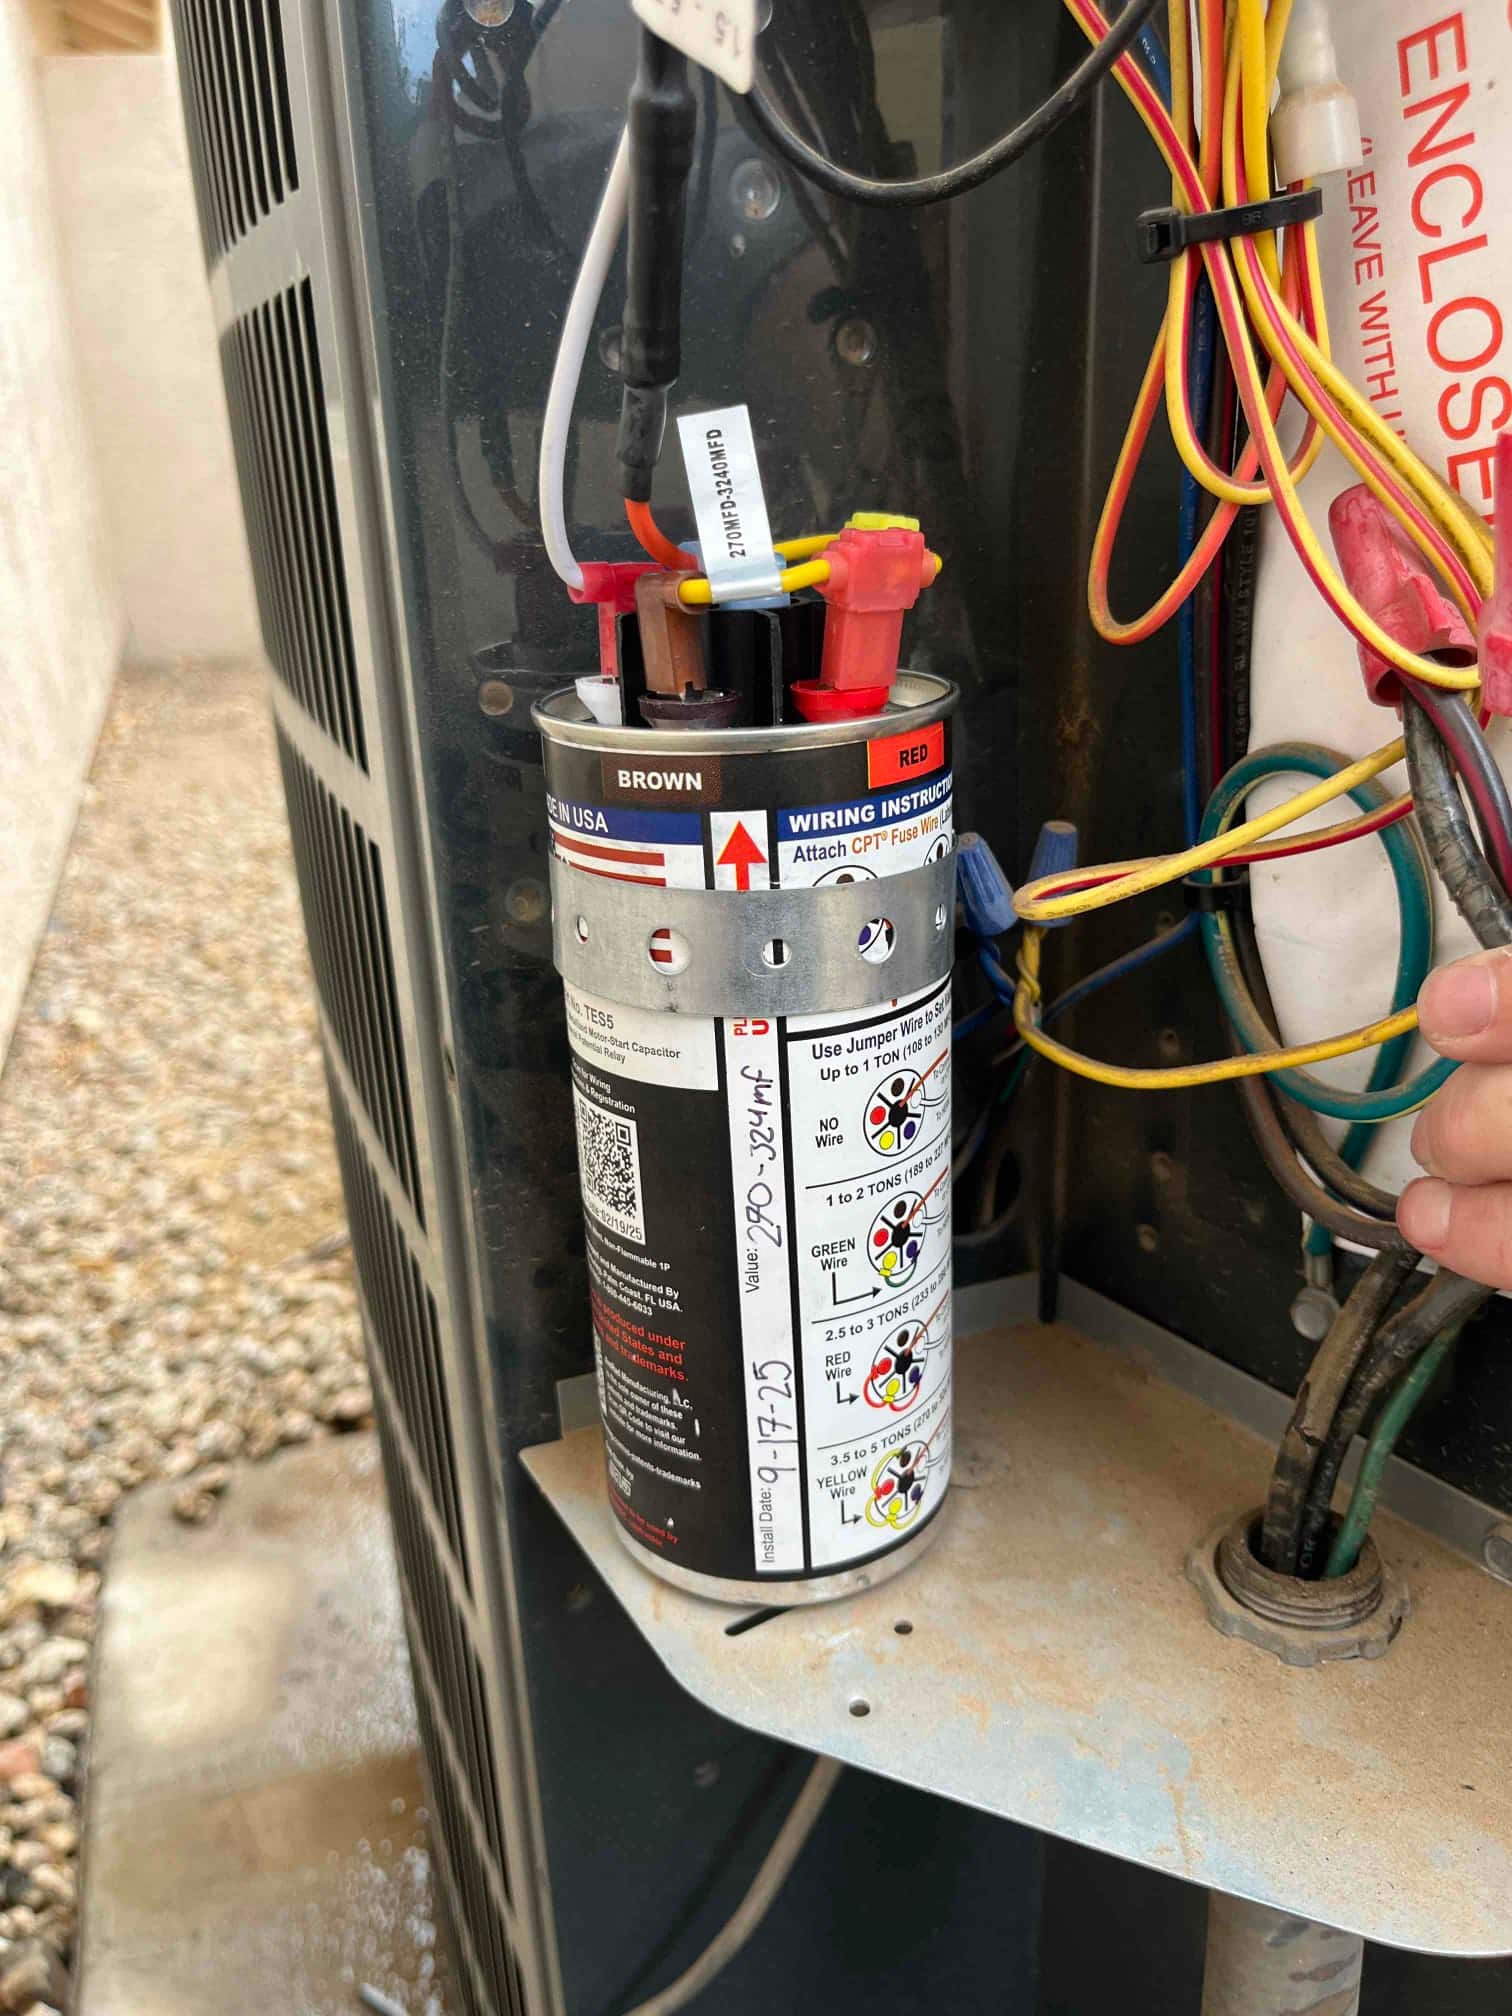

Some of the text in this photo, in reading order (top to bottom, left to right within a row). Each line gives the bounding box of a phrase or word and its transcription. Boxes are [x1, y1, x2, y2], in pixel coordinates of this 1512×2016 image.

[1346, 168, 1385, 286] EAVE
[1397, 12, 1512, 526] ENCLOSE
[1359, 289, 1399, 402] WITH
[705, 428, 747, 559] 270MFD-3240MFD
[898, 743, 930, 769] RED
[617, 769, 703, 791] BROWN
[559, 800, 571, 825] IN
[573, 806, 609, 833] USA
[789, 804, 876, 833] WIRING
[793, 840, 847, 864] Attach
[891, 826, 919, 847] Fuse
[920, 815, 940, 837] Wire
[584, 1003, 615, 1030] TES5
[733, 1016, 749, 1036] PL
[812, 1044, 843, 1060] Use
[846, 1028, 898, 1054] Jumper
[900, 1016, 924, 1038] Wire
[925, 1008, 934, 1024] to
[934, 999, 945, 1019] Set
[604, 1046, 626, 1065] Relay
[631, 1041, 682, 1060] Capacitor
[820, 1067, 841, 1082] Up
[845, 1062, 859, 1077] to
[863, 1059, 870, 1072] 1
[874, 1049, 900, 1069] TON
[903, 1037, 923, 1061] (108
[924, 1034, 933, 1048] to
[589, 1072, 611, 1094] Wiring
[590, 1086, 636, 1114] Registration
[819, 1117, 839, 1133] NO
[815, 1133, 844, 1149] Wire
[826, 1195, 834, 1208] 1
[838, 1192, 853, 1205] to
[856, 1188, 864, 1201] 2
[867, 1173, 902, 1197] TONS
[904, 1159, 924, 1185] (189
[925, 1156, 933, 1169] to
[811, 1237, 856, 1258] GREEN
[659, 1262, 671, 1272] 1P
[744, 1247, 760, 1294] Value:
[820, 1256, 848, 1273] Wire
[610, 1261, 664, 1295] Manufactured
[665, 1285, 680, 1300] By
[644, 1293, 657, 1306] FL
[658, 1297, 684, 1313] USA.
[825, 1327, 847, 1342] 2.5
[849, 1322, 863, 1336] to
[866, 1318, 874, 1330] 3
[877, 1302, 909, 1326] TONS
[911, 1287, 929, 1311] (233
[648, 1331, 687, 1351] under
[620, 1344, 688, 1382] trademarks.
[658, 1350, 683, 1366] and
[825, 1351, 851, 1368] RED
[825, 1365, 852, 1382] Wire
[651, 1402, 660, 1411] of
[660, 1405, 684, 1420] these
[752, 1359, 799, 1485] 9-17-25
[653, 1439, 702, 1461] information.
[671, 1433, 687, 1445] our
[830, 1450, 851, 1467] 3.5
[854, 1446, 867, 1460] to
[871, 1442, 878, 1454] 5
[880, 1425, 912, 1449] TONS
[816, 1465, 868, 1490] YELLOW
[830, 1485, 856, 1501] Wire
[759, 1487, 775, 1564] Install Date:
